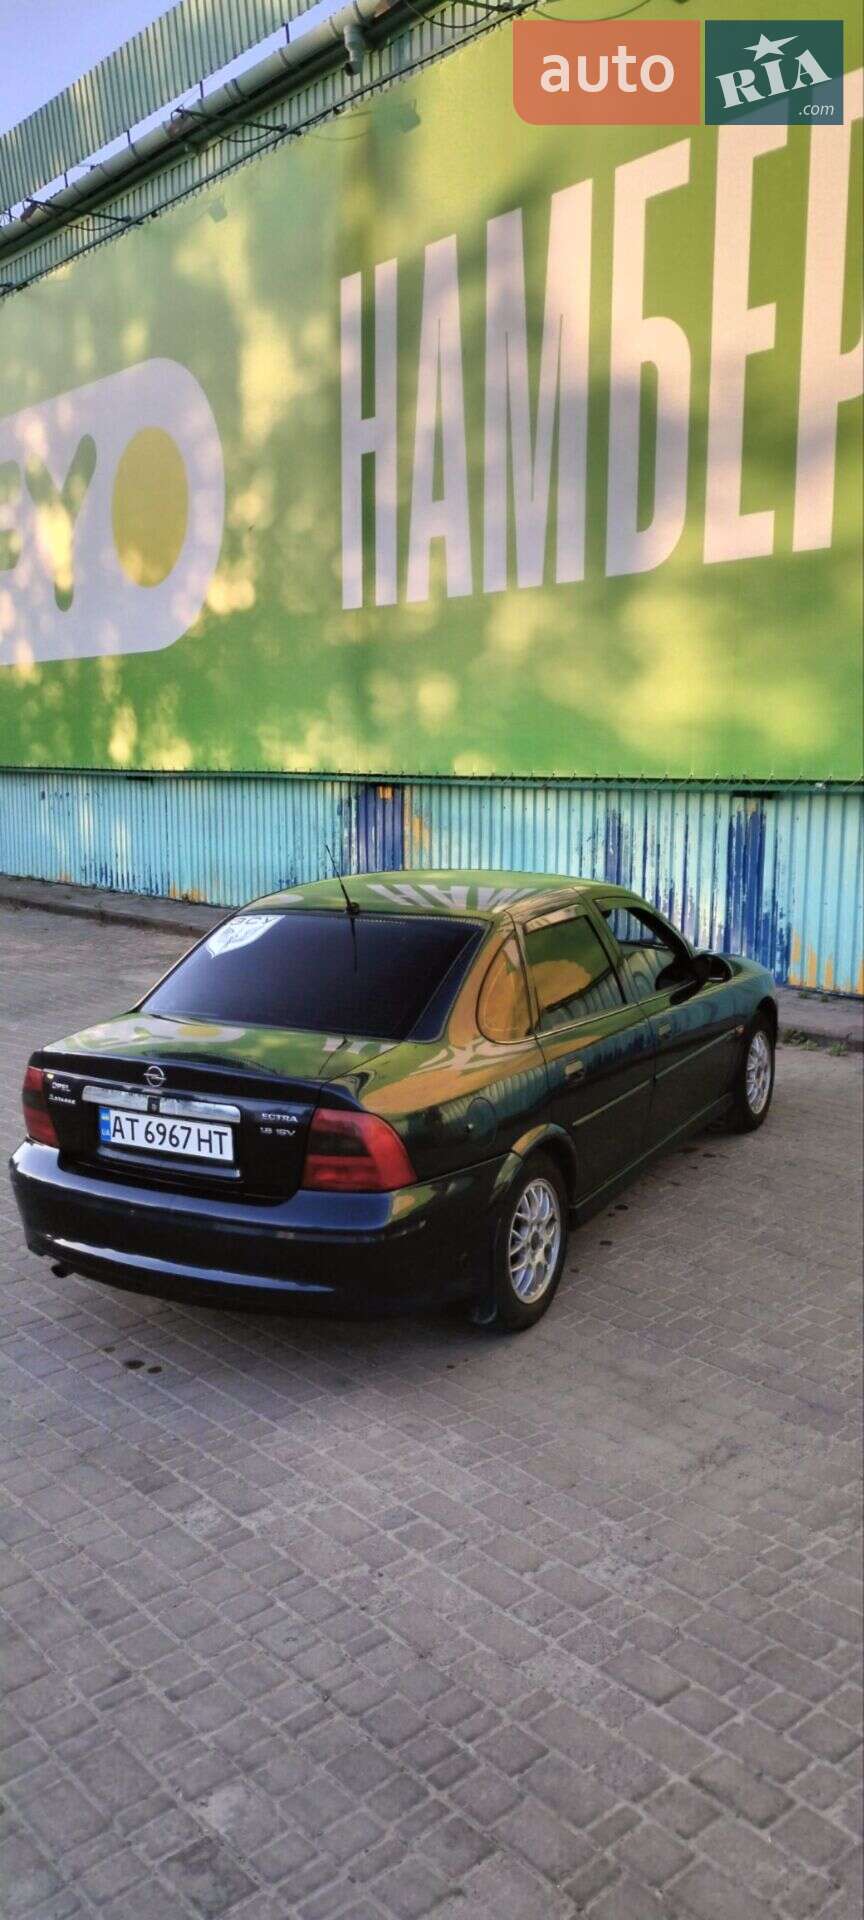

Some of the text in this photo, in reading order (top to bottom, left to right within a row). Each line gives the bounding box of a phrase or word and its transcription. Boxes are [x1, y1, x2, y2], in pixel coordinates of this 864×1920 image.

[112, 1115, 228, 1155] AT 6967 HT
